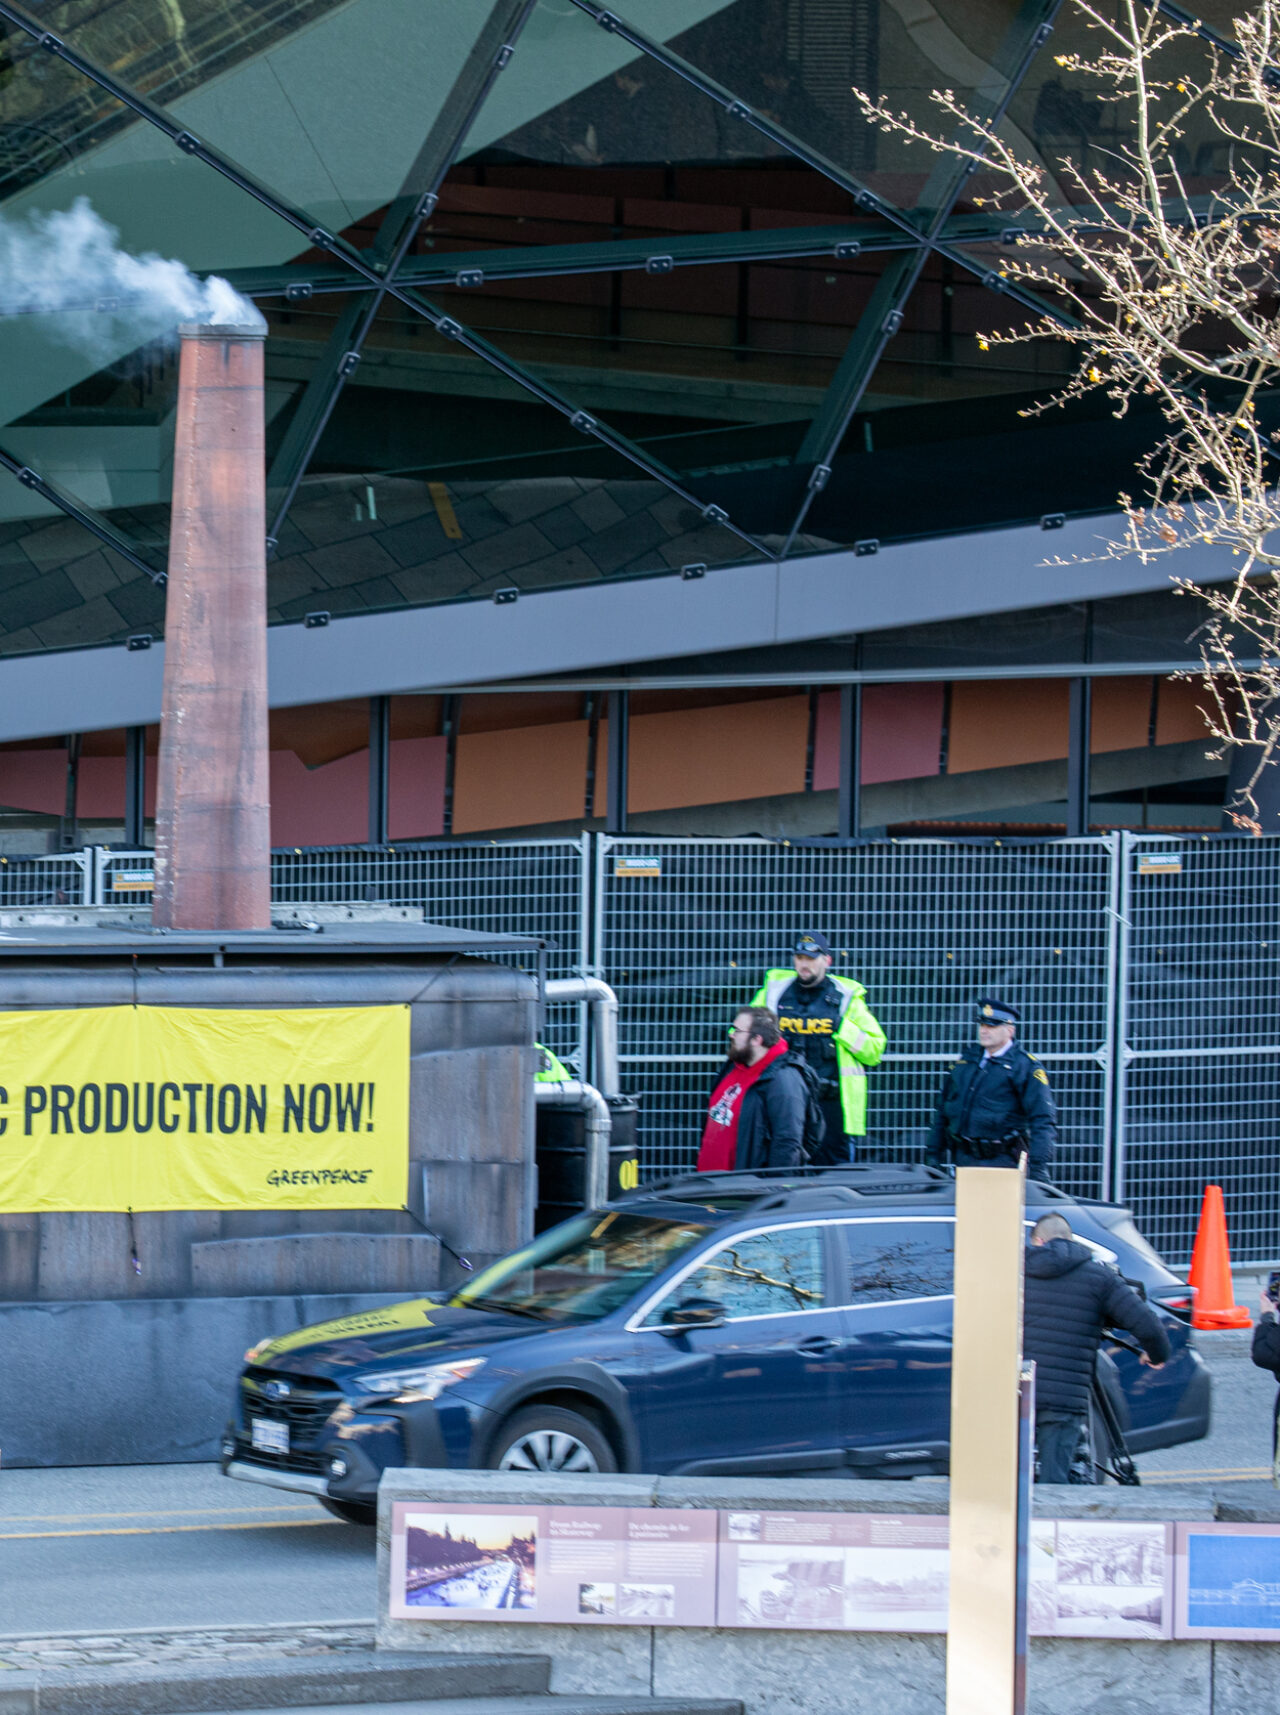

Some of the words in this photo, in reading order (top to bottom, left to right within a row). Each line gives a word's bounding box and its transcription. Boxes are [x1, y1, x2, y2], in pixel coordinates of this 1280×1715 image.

[779, 1016, 834, 1035] POLICE
[23, 1081, 268, 1136] PRODUCTION
[282, 1081, 376, 1134] NOW!
[266, 1168, 374, 1187] GREENPEACE
